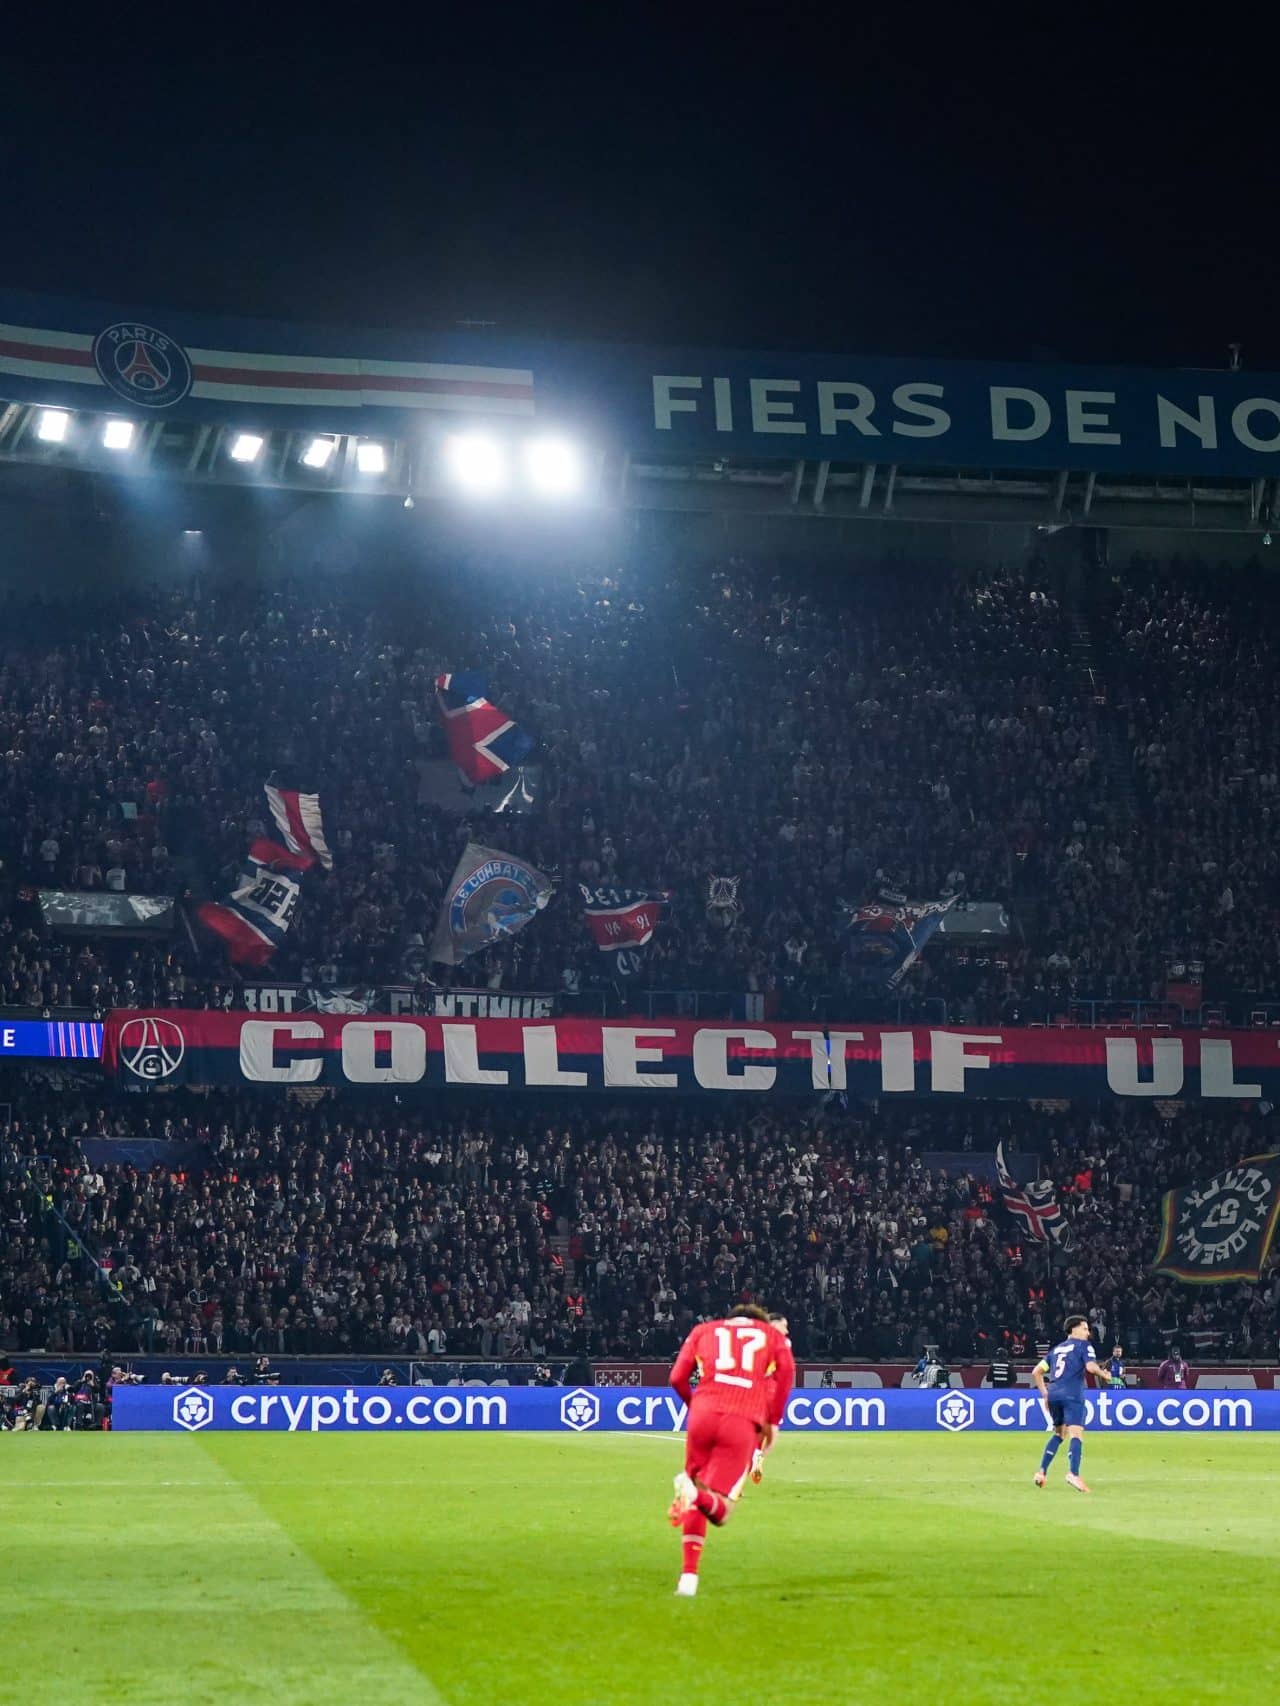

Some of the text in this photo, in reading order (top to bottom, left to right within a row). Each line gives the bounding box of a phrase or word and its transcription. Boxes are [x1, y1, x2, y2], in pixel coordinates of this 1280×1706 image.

[107, 327, 169, 351] PARIS
[652, 375, 951, 438] FIERS
[989, 385, 1121, 445] DE
[240, 1019, 1003, 1093] COLLECTIF
[714, 1327, 766, 1372] 17
[1054, 1353, 1068, 1379] 5
[231, 1389, 507, 1431] crypto.com
[616, 1395, 886, 1432] crycom
